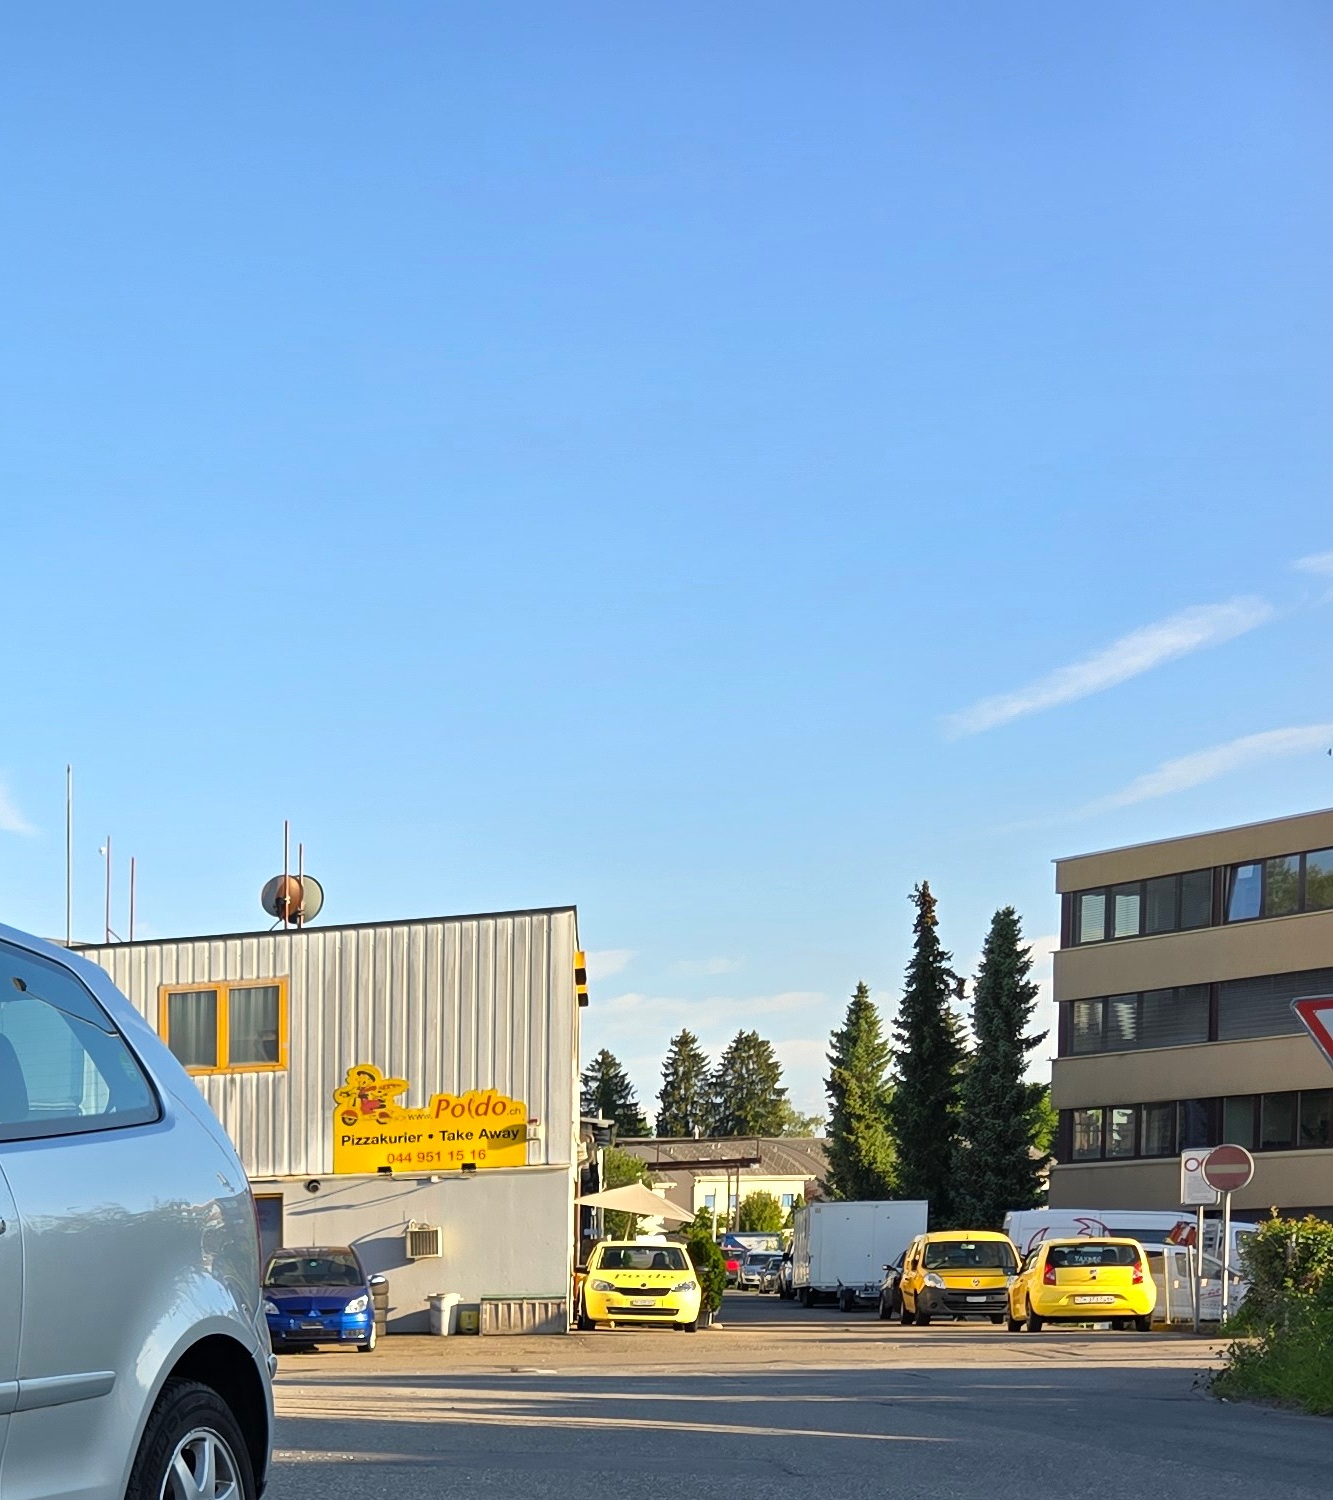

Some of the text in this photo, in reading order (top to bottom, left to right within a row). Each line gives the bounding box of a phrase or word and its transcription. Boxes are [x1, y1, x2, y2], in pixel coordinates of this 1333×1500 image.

[341, 1128, 520, 1146] Pizzakurier Take Away
[387, 1149, 486, 1164] 044 951 15 16
